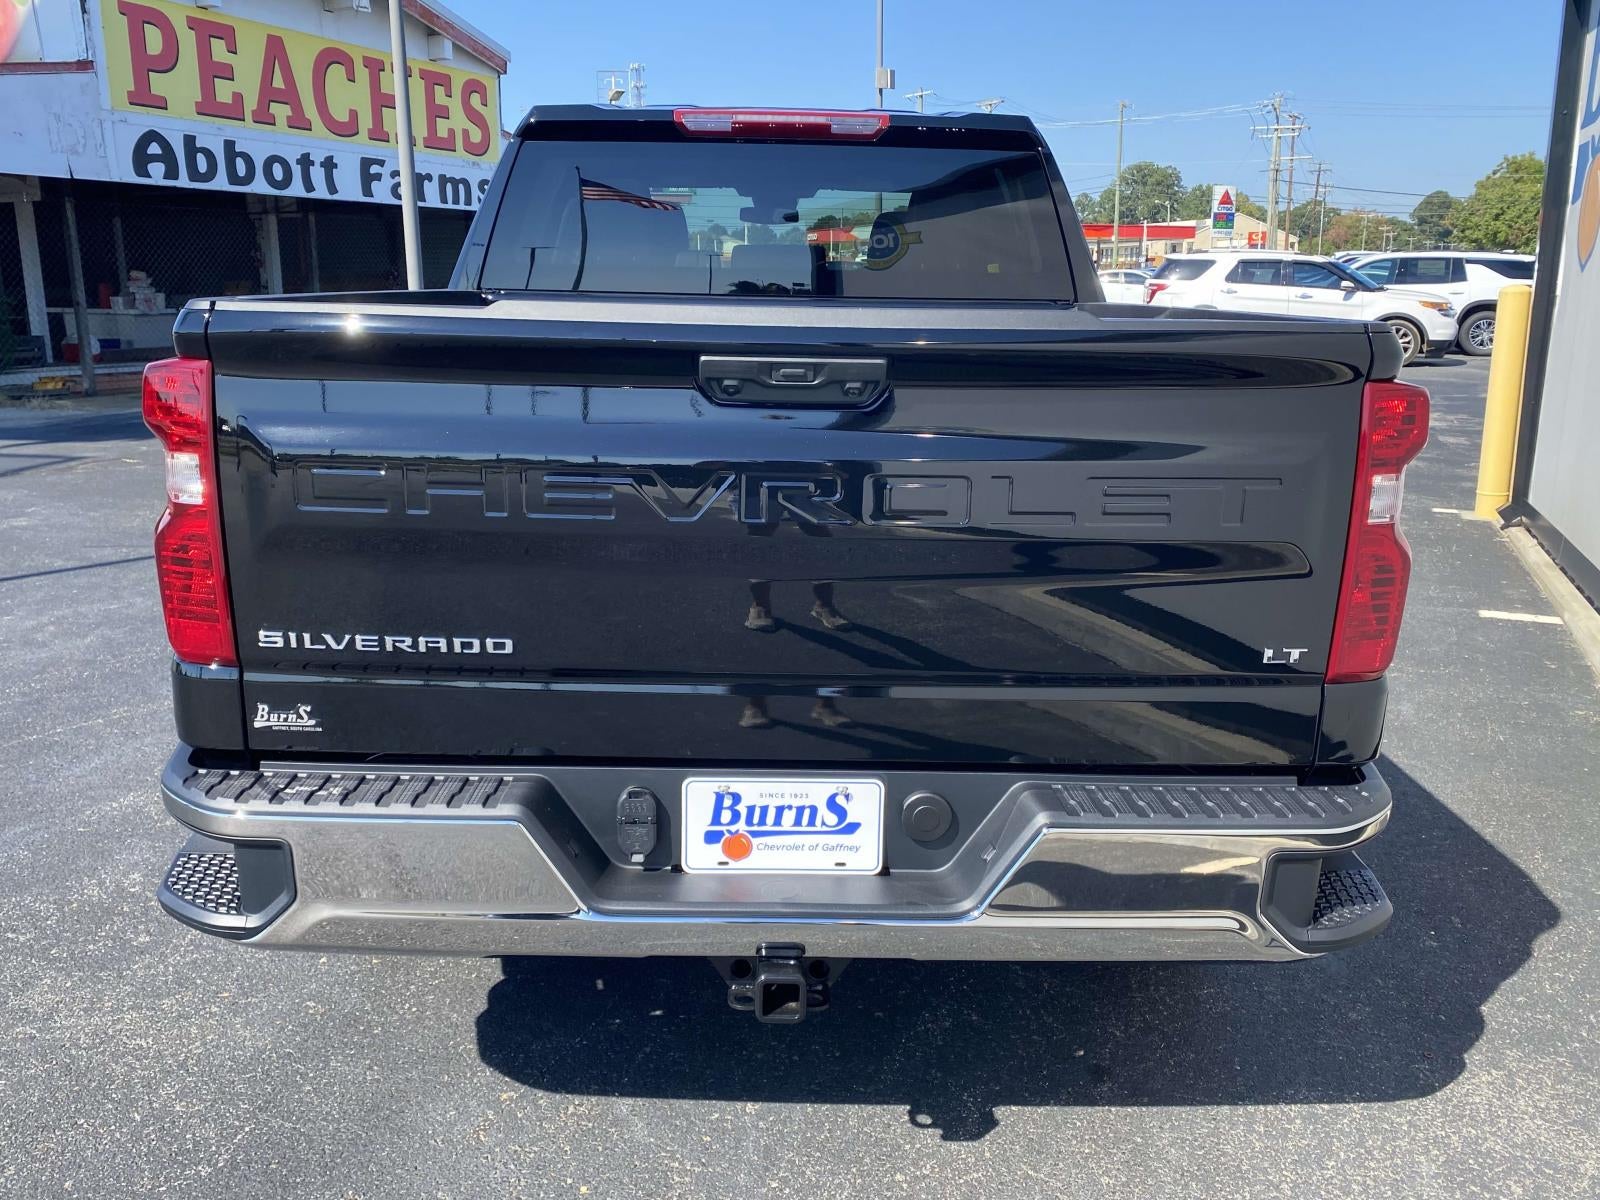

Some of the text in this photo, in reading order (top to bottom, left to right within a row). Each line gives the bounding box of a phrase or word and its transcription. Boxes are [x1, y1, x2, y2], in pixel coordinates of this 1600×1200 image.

[117, 0, 490, 157] PEACHES
[132, 129, 338, 196] Abbott
[295, 463, 1283, 527] CHEVROLET
[258, 629, 513, 654] SILVERADO
[1263, 648, 1308, 663] LT
[756, 842, 861, 854] Chevrolet of Gaffney
